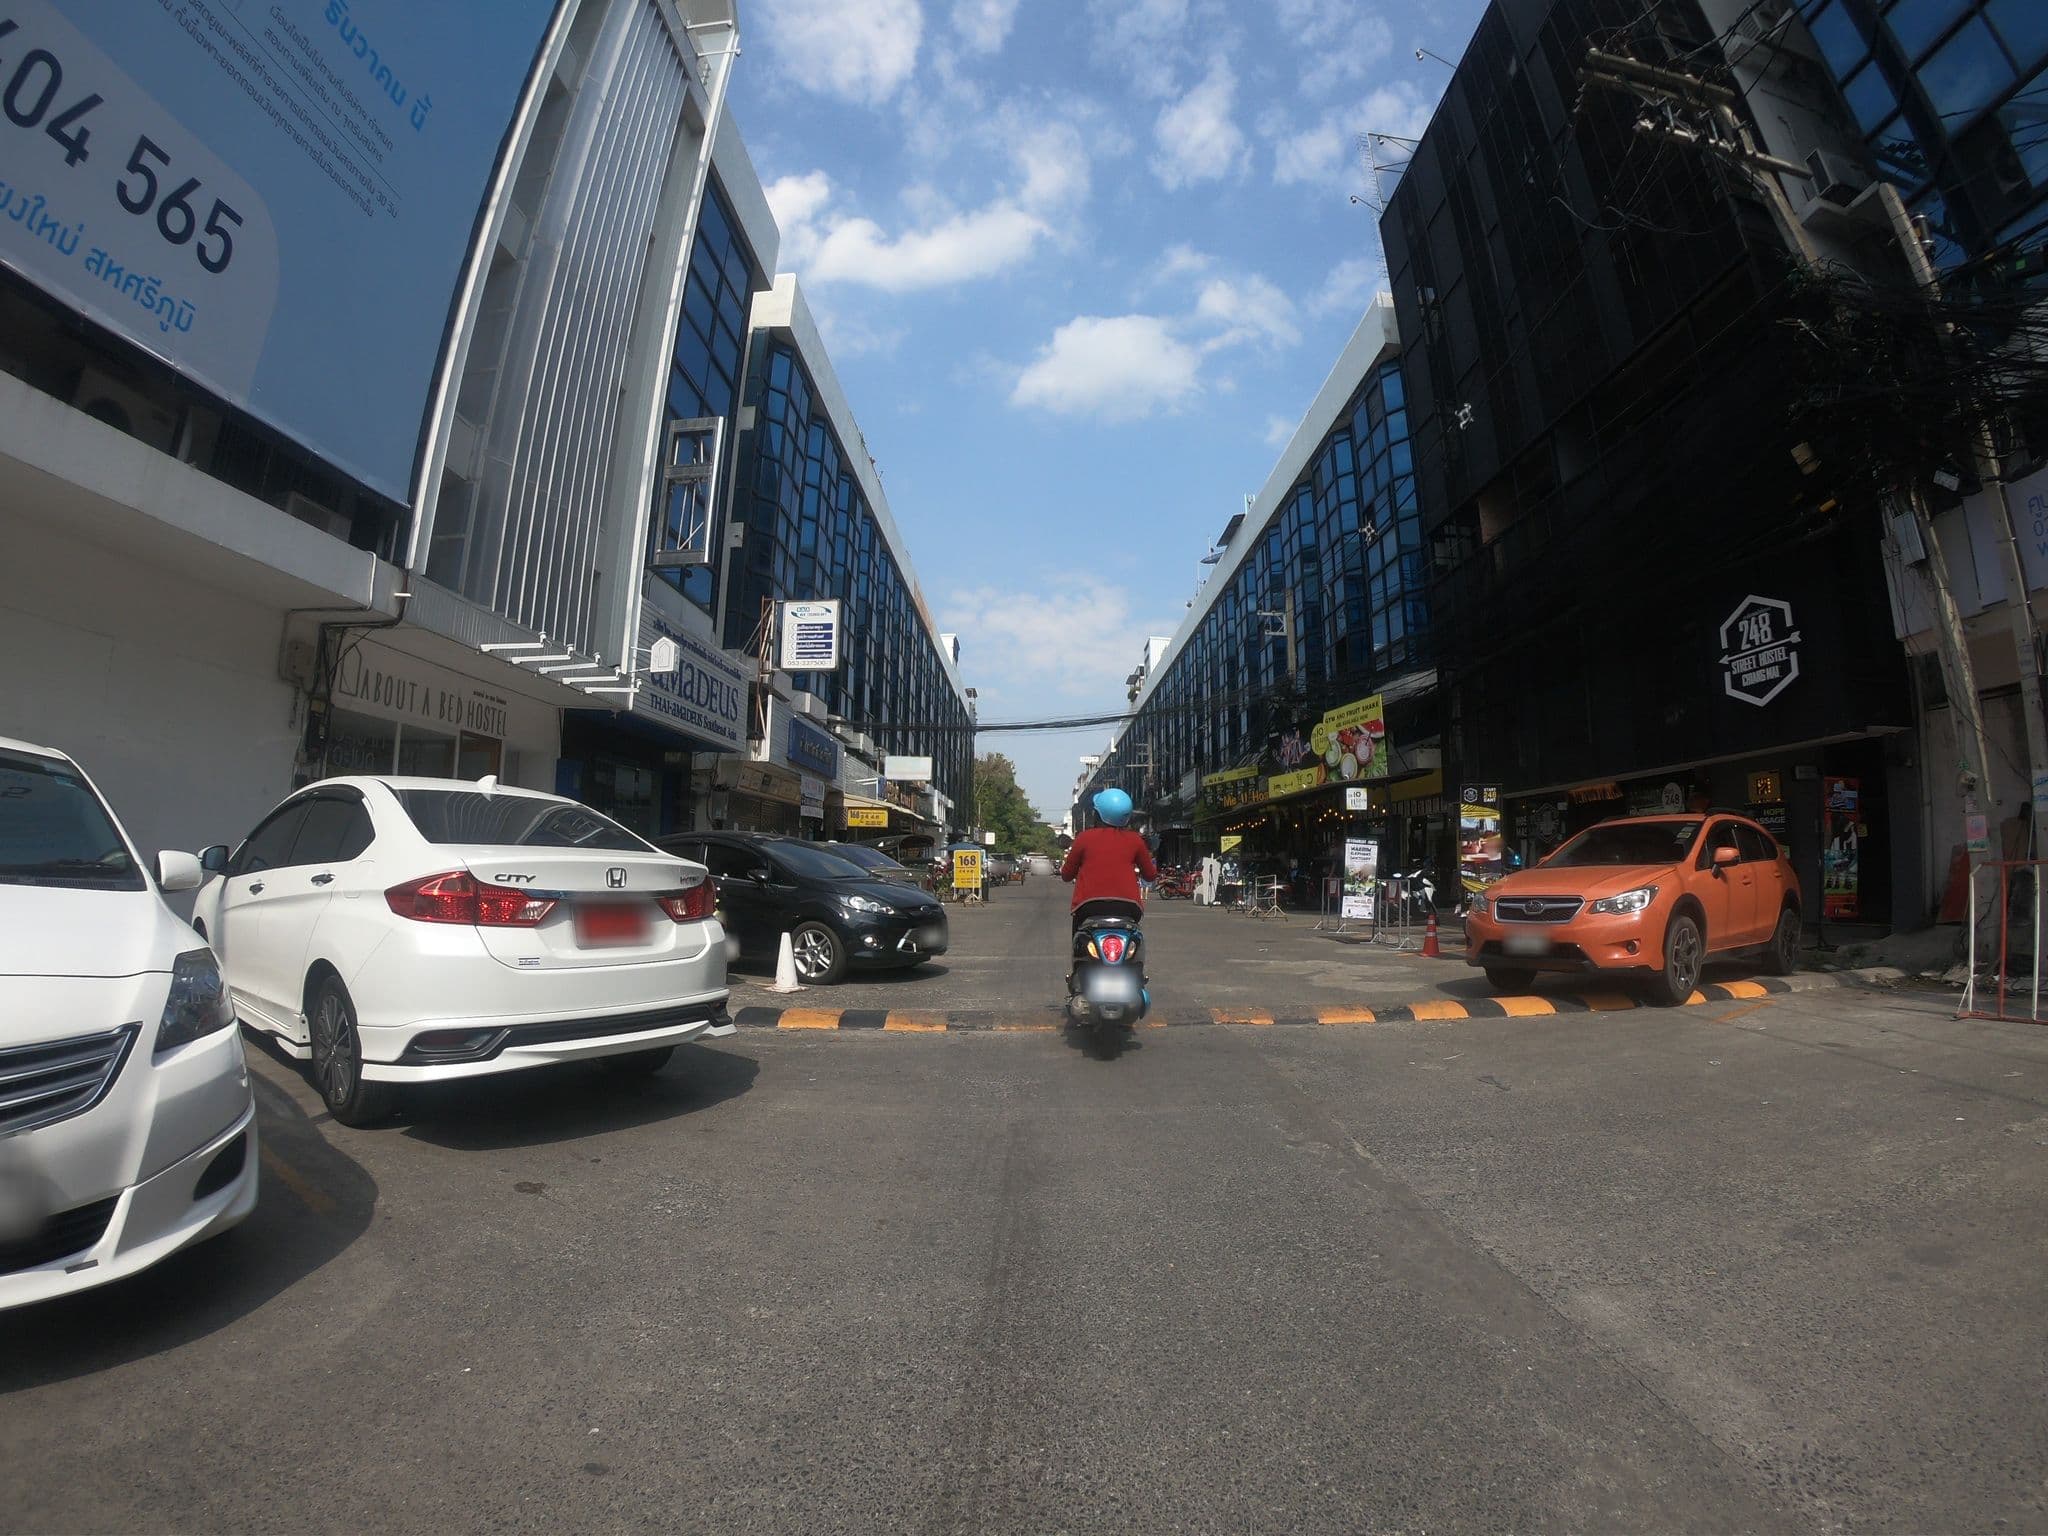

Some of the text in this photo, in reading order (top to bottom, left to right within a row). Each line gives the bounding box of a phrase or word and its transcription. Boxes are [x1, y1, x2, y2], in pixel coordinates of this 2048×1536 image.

[411, 94, 432, 131] นี้
[116, 134, 244, 274] 565
[376, 191, 387, 206] 30
[387, 202, 398, 218] วัน
[85, 247, 196, 332] สหศรีภูมิ
[1738, 613, 1773, 650] 248
[1731, 646, 1789, 675] STREET HOSTEL
[1741, 665, 1780, 687] CHIANG MAI
[360, 668, 418, 712] ABOUT
[422, 687, 431, 717] A
[439, 691, 463, 724] BED
[467, 700, 508, 737] HOSTEL
[1346, 707, 1360, 716] FRUIT
[1362, 701, 1378, 712] SHAKE
[1664, 793, 1680, 806] 248
[1755, 816, 1786, 824] ASSAGE
[958, 855, 976, 866] 168
[494, 873, 537, 883] CITY
